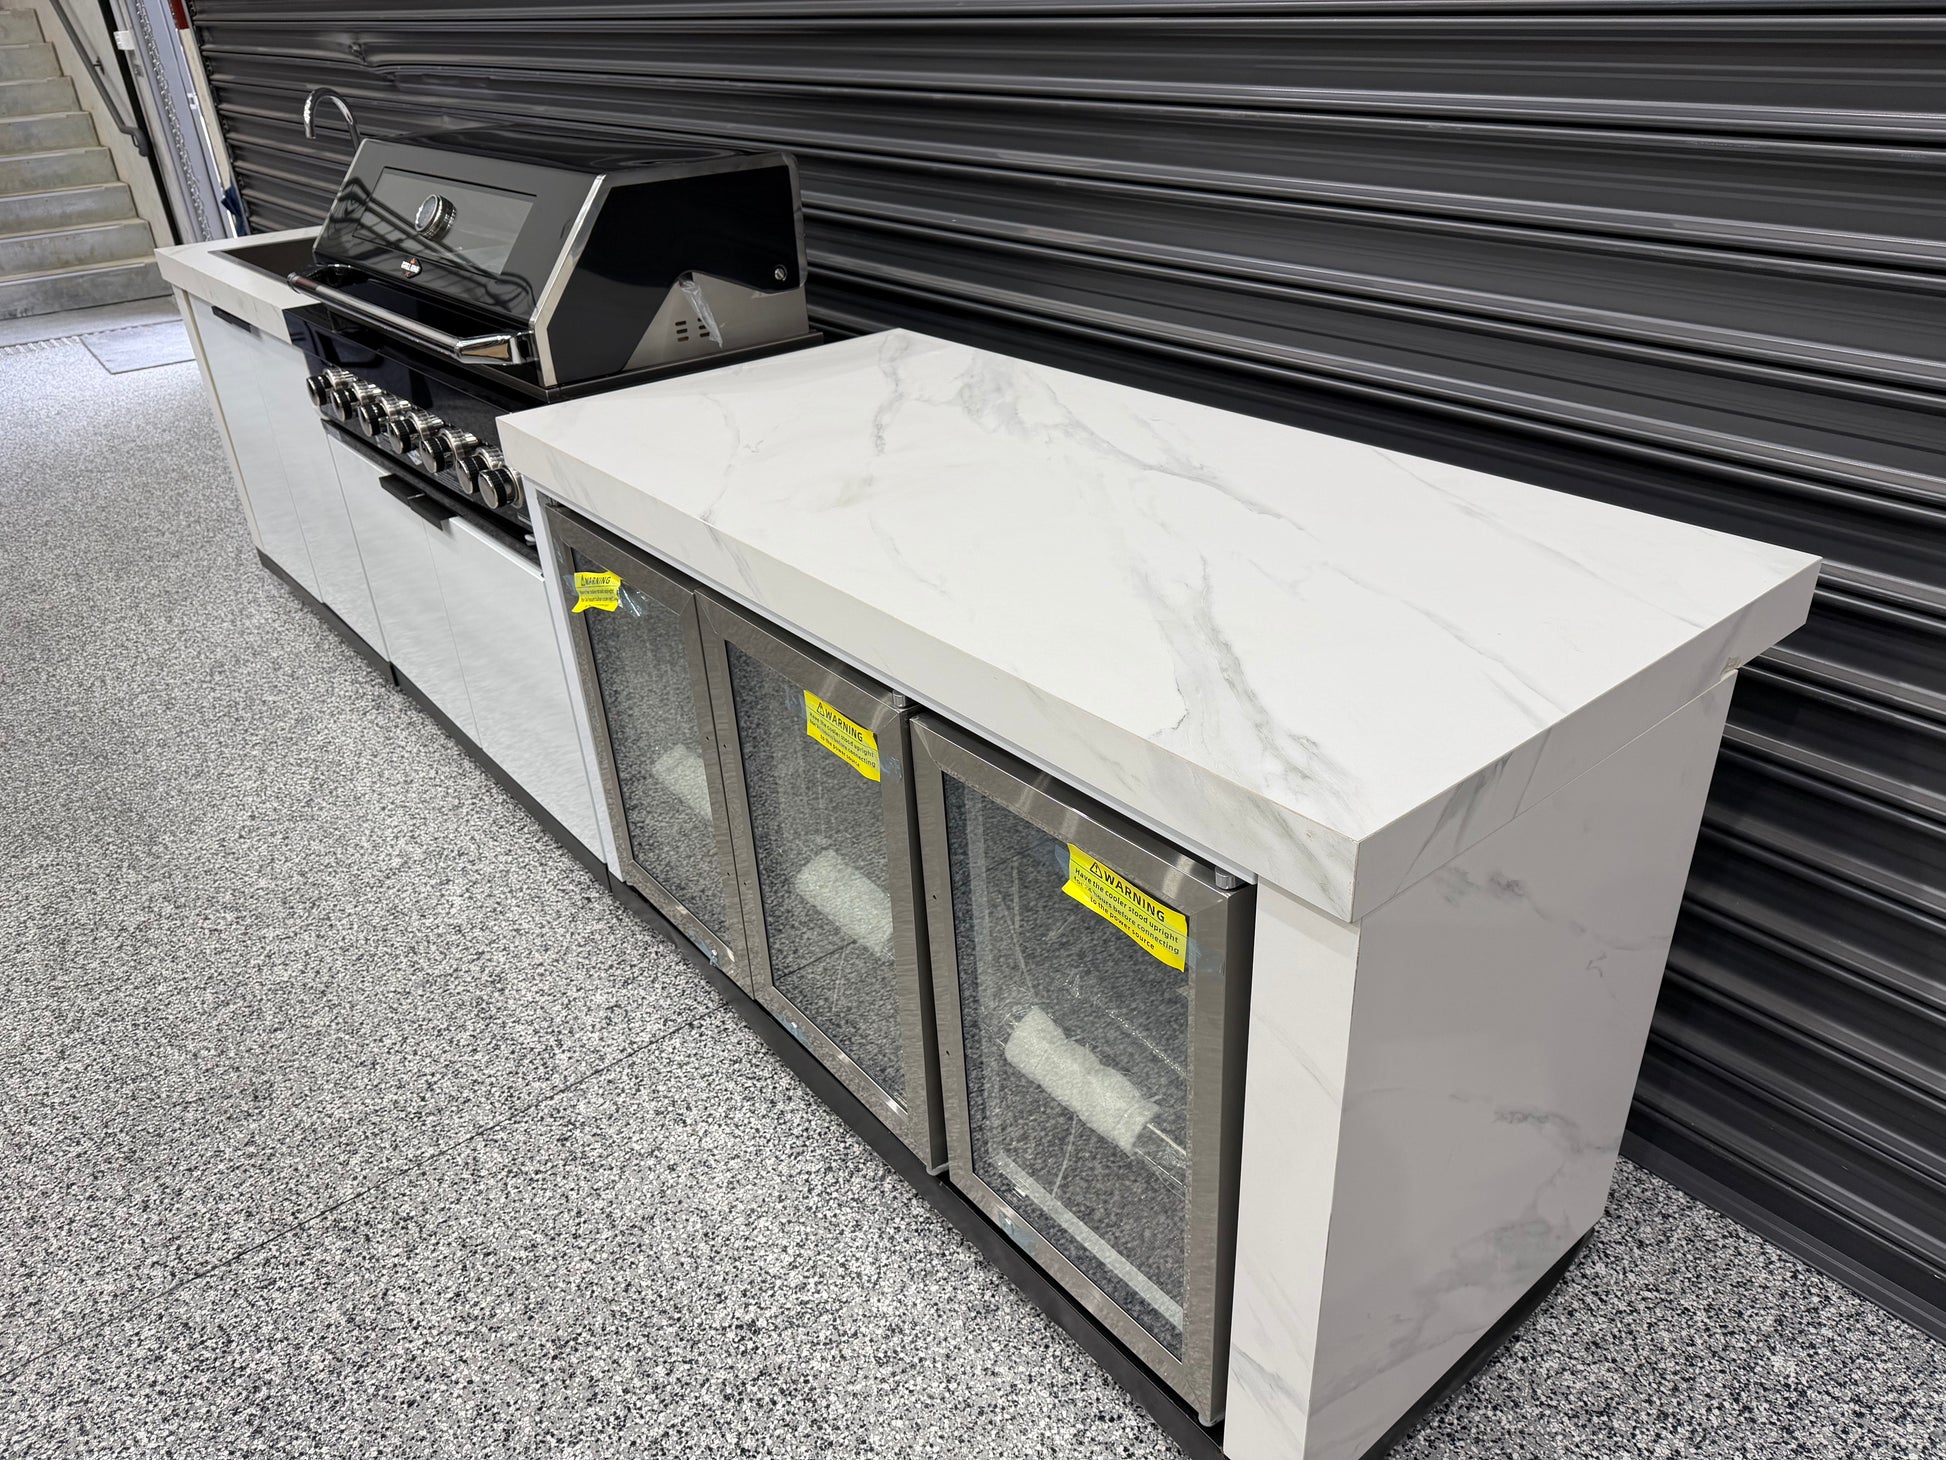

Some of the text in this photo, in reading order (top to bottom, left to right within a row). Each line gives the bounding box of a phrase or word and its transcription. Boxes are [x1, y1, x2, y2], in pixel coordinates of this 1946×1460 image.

[825, 708, 863, 742] WARNING
[854, 744, 874, 758] upright
[1076, 868, 1179, 943] Have the cooler stood upright
[1104, 870, 1165, 923] WARNING
[1090, 896, 1155, 950] to the power source
[1113, 904, 1136, 925] before
[1137, 922, 1180, 955] connecting
